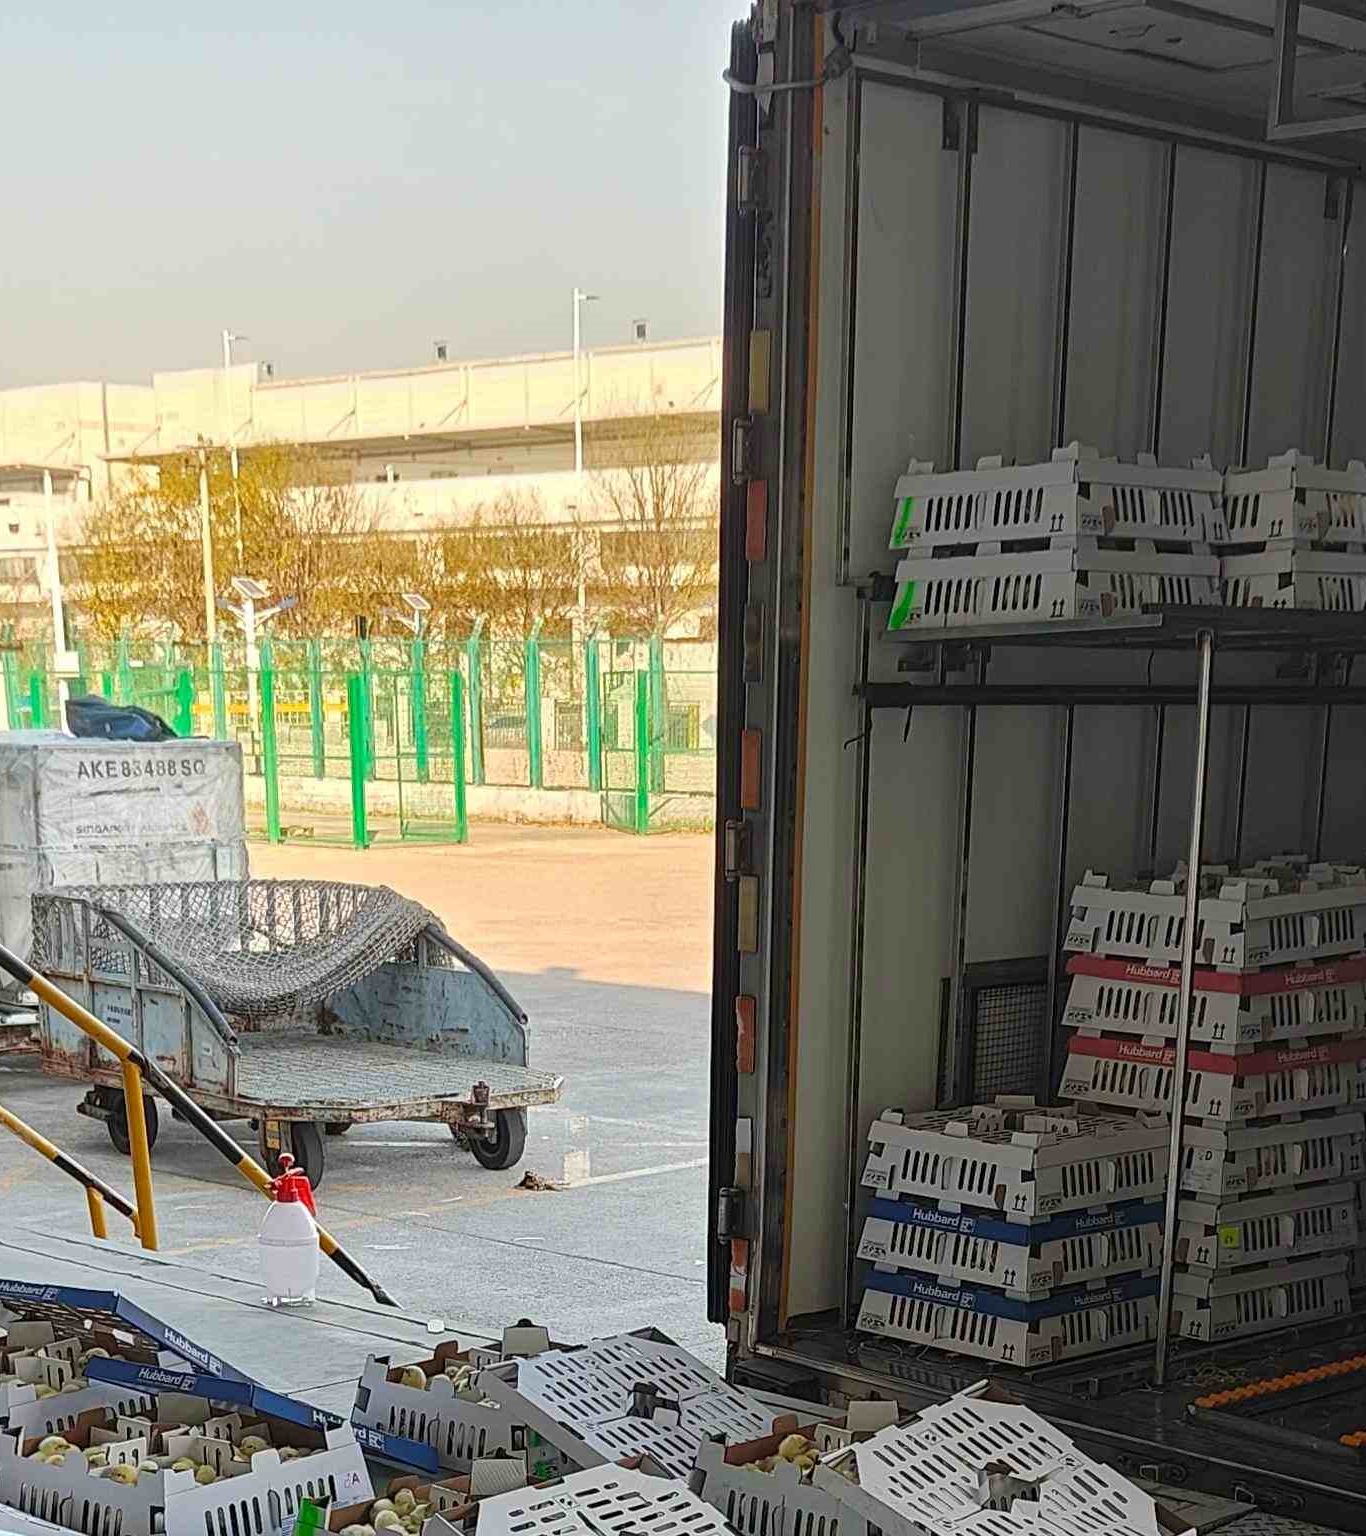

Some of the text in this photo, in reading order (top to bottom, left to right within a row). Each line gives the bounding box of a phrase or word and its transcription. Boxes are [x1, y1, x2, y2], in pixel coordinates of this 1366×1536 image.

[77, 760, 118, 780] AKE
[121, 760, 176, 778] 83488
[1125, 964, 1172, 980] Hubbard
[1118, 1043, 1163, 1059] Hubbard
[912, 1207, 959, 1227] Hubbard
[1075, 1213, 1114, 1228] Hubbard
[912, 1281, 960, 1302] Hubbard
[1073, 1291, 1112, 1306] Hubbard
[163, 1327, 209, 1365] Hubbard
[138, 1367, 182, 1386] Hubbard
